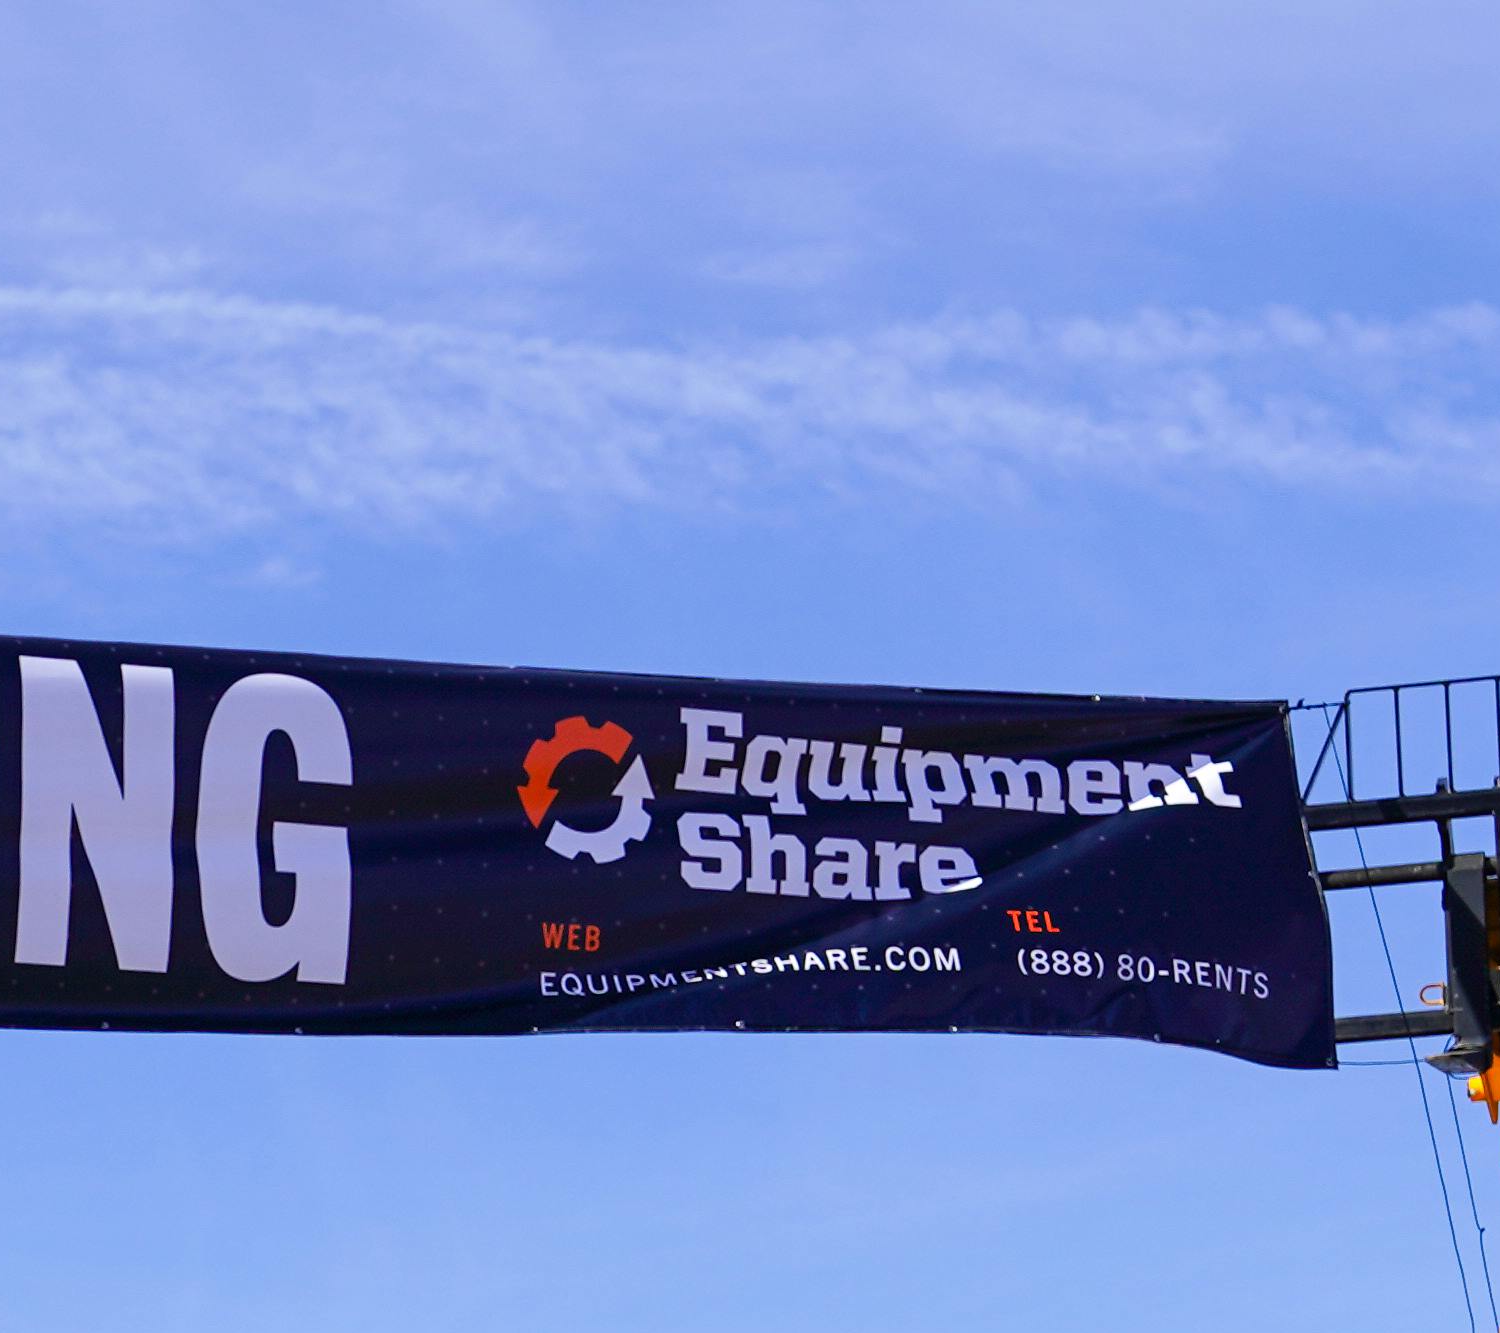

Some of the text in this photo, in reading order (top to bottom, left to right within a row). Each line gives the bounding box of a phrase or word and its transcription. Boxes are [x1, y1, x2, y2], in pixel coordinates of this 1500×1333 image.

[675, 707, 1242, 823] Equipment
[676, 812, 983, 900] Share
[541, 922, 601, 952] WEB
[1006, 909, 1061, 933] TEL
[540, 945, 962, 997] EQUIPMENTSHARE.COM
[1017, 948, 1270, 999] (888) 80-RENTS
